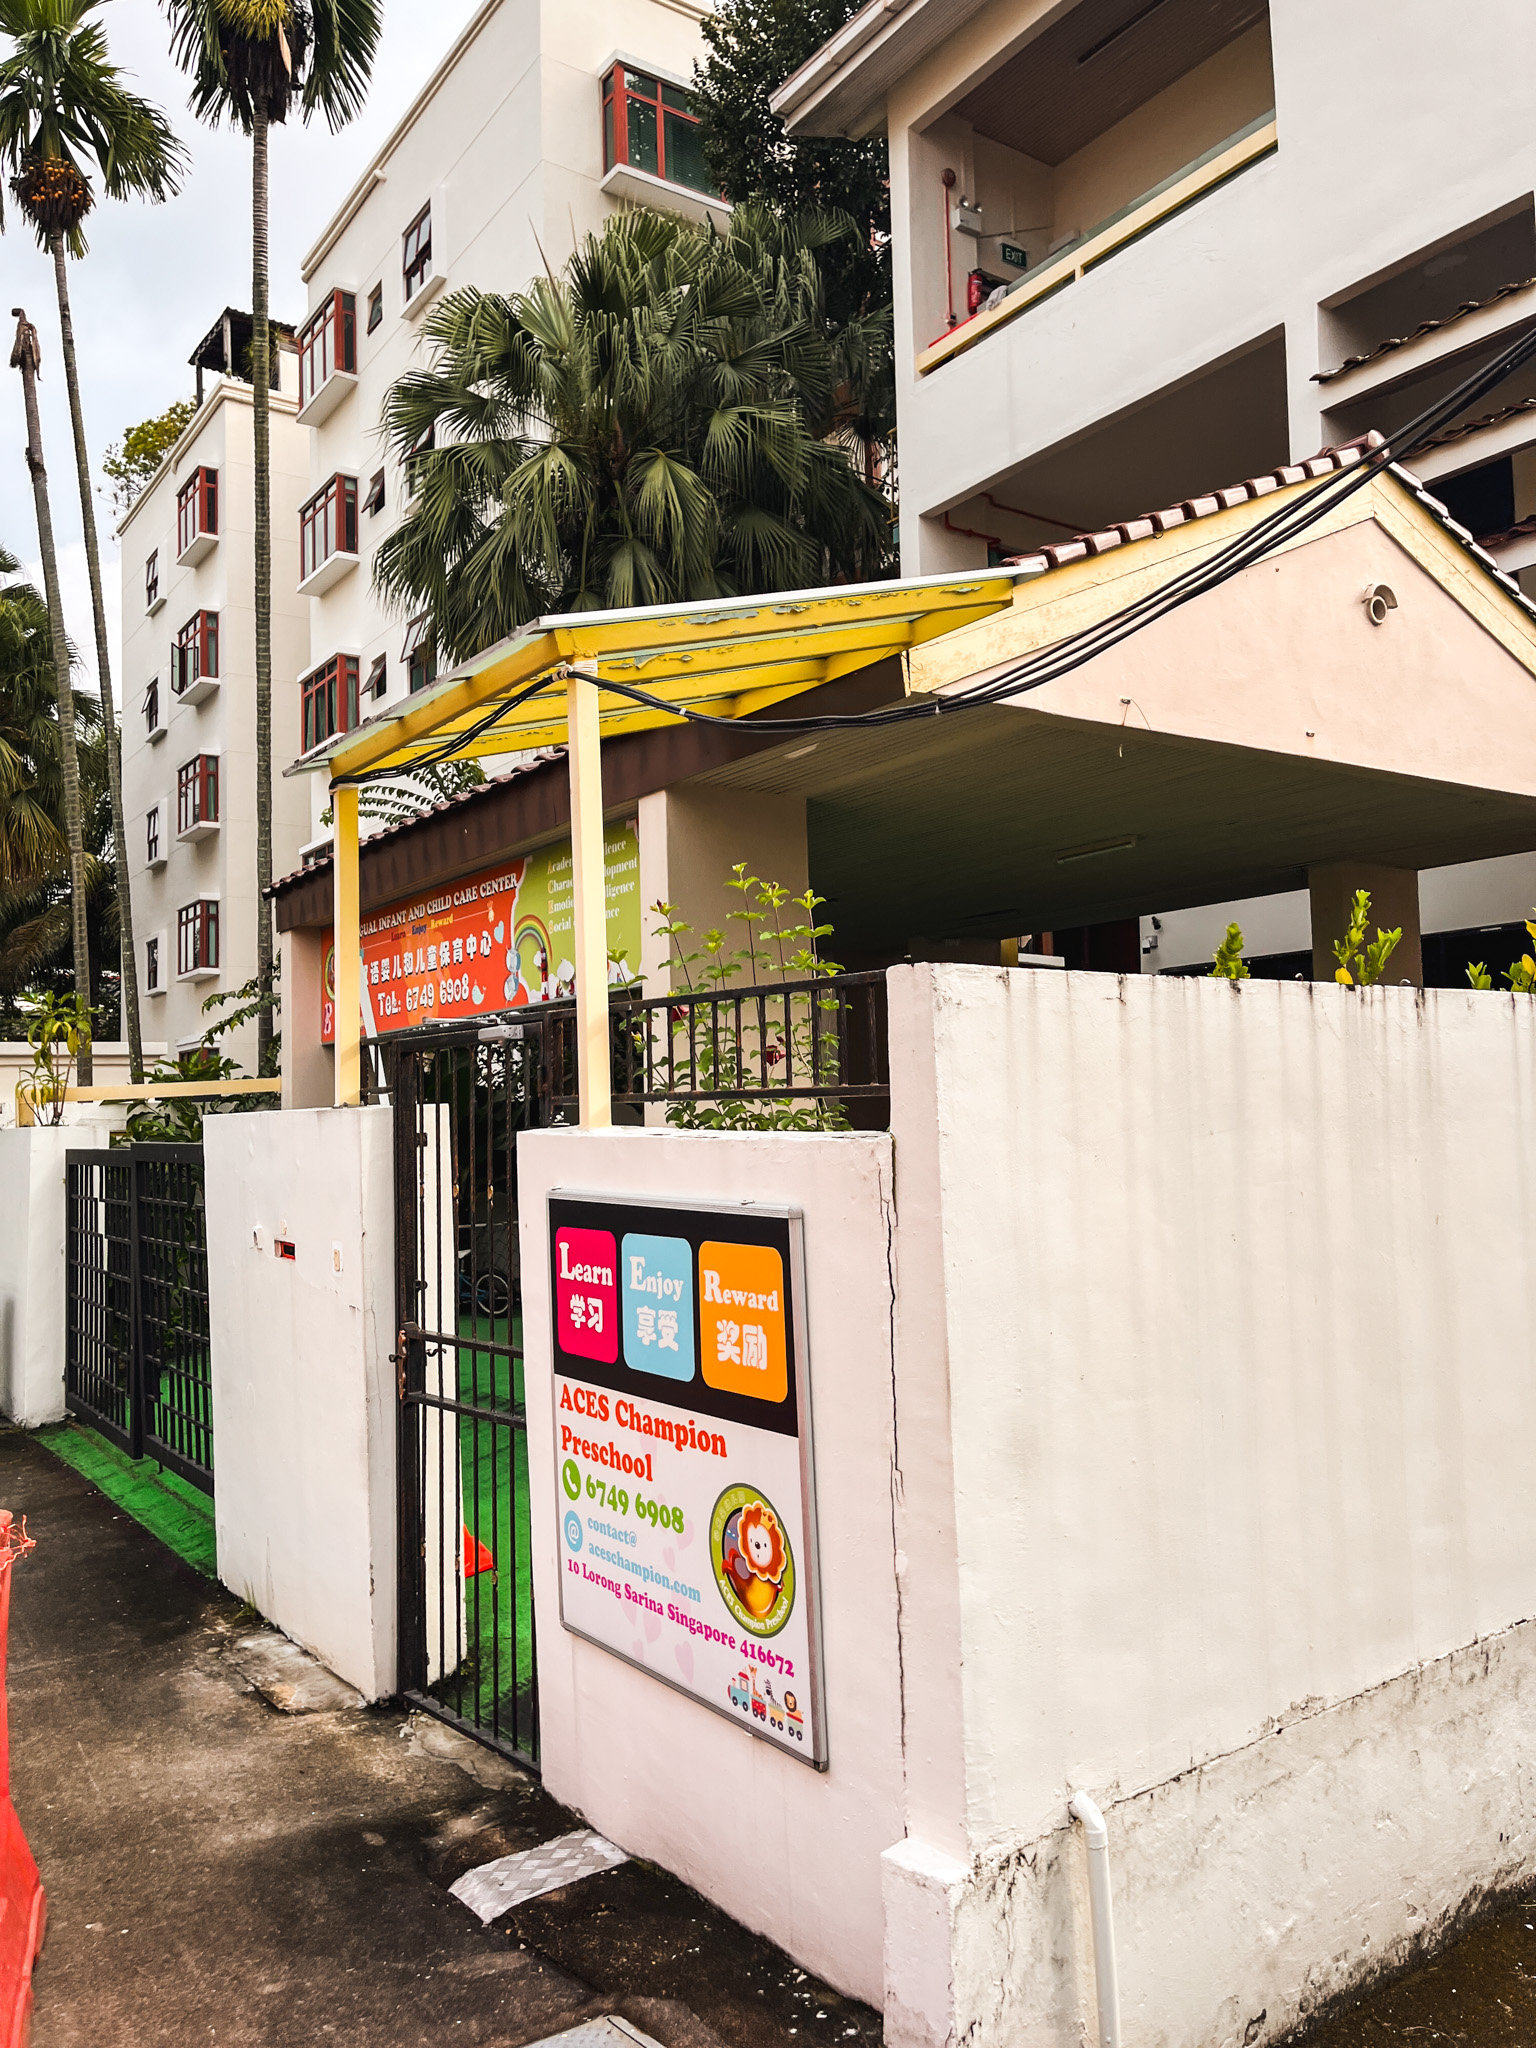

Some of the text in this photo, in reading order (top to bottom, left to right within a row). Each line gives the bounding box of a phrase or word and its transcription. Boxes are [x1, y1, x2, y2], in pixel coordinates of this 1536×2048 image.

[1005, 248, 1023, 264] EXIT
[604, 840, 627, 856] lence
[604, 857, 637, 879] lopment
[359, 873, 517, 937] GUAL INFANT AND CHILD CARE CENTER
[605, 881, 635, 900] ligence
[391, 913, 453, 941] Learn Enjoy Reward
[548, 916, 571, 935] Social
[377, 973, 469, 1016] Tel: 6749 6908
[559, 1241, 779, 1312] Learn Enjoy Reward
[569, 1293, 768, 1370] 学习 享受 奖励
[560, 1383, 728, 1458] ACES Champion
[561, 1424, 653, 1482] Preschool
[586, 1473, 629, 1516] 6749
[635, 1492, 684, 1534] 6908
[587, 1517, 637, 1548] contact@
[588, 1542, 701, 1603] aceschampion.com
[567, 1558, 795, 1678] 10 Lorong Sarina Singapore 416672
[719, 1579, 789, 1630] ACES Champion Preschool
